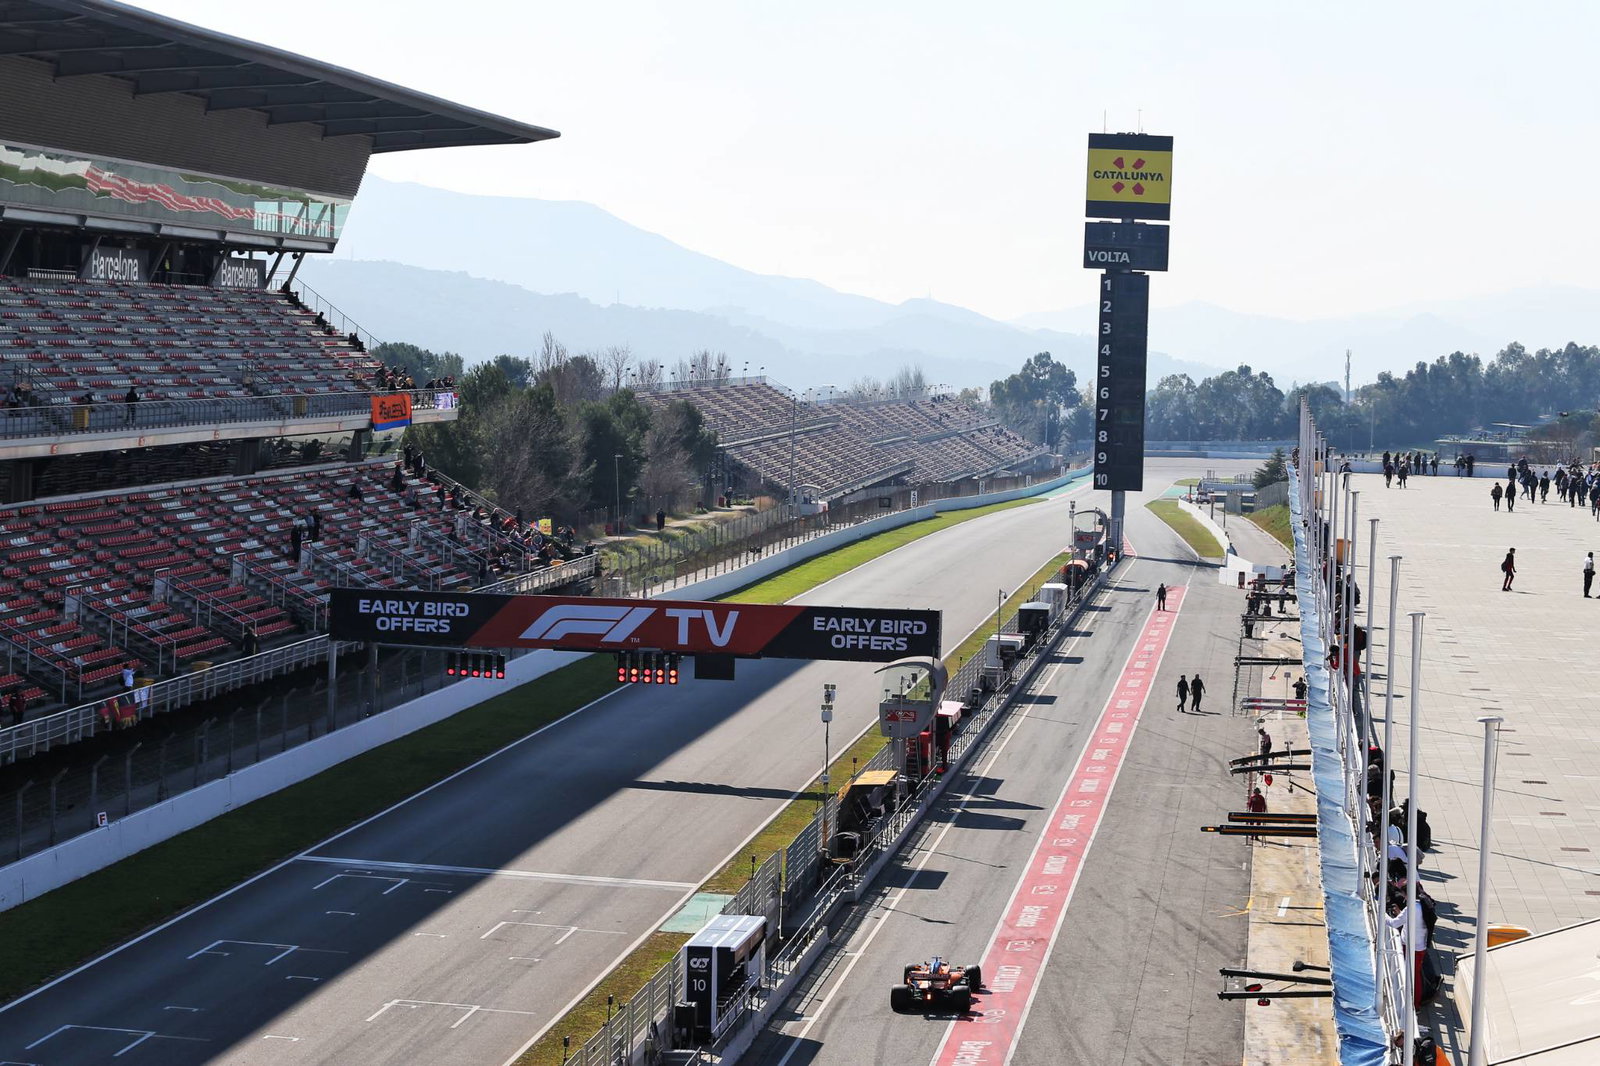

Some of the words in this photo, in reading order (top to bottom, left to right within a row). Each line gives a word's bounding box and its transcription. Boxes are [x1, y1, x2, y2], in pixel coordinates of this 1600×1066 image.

[1093, 170, 1164, 182] CATALUNYA
[1088, 250, 1130, 263] VOLTA
[91, 249, 139, 281] Barcelona
[221, 257, 259, 287] Barcelona
[1104, 279, 1112, 291] 1
[1102, 300, 1112, 313] 2
[1102, 322, 1111, 335] 3
[1101, 344, 1111, 356] 4
[1101, 365, 1110, 378] 5
[1100, 387, 1110, 399] 6
[1099, 408, 1109, 421] 7
[1098, 430, 1108, 442] 8
[1098, 452, 1107, 464] 9
[1095, 473, 1108, 486] 10
[359, 599, 420, 615] EARLY
[423, 602, 470, 617] BIRD
[376, 616, 451, 633] OFFERS
[665, 608, 740, 647] TV
[813, 616, 876, 633] EARLY
[880, 619, 928, 635] BIRD
[831, 634, 908, 651] OFFERS
[692, 978, 706, 992] 10
